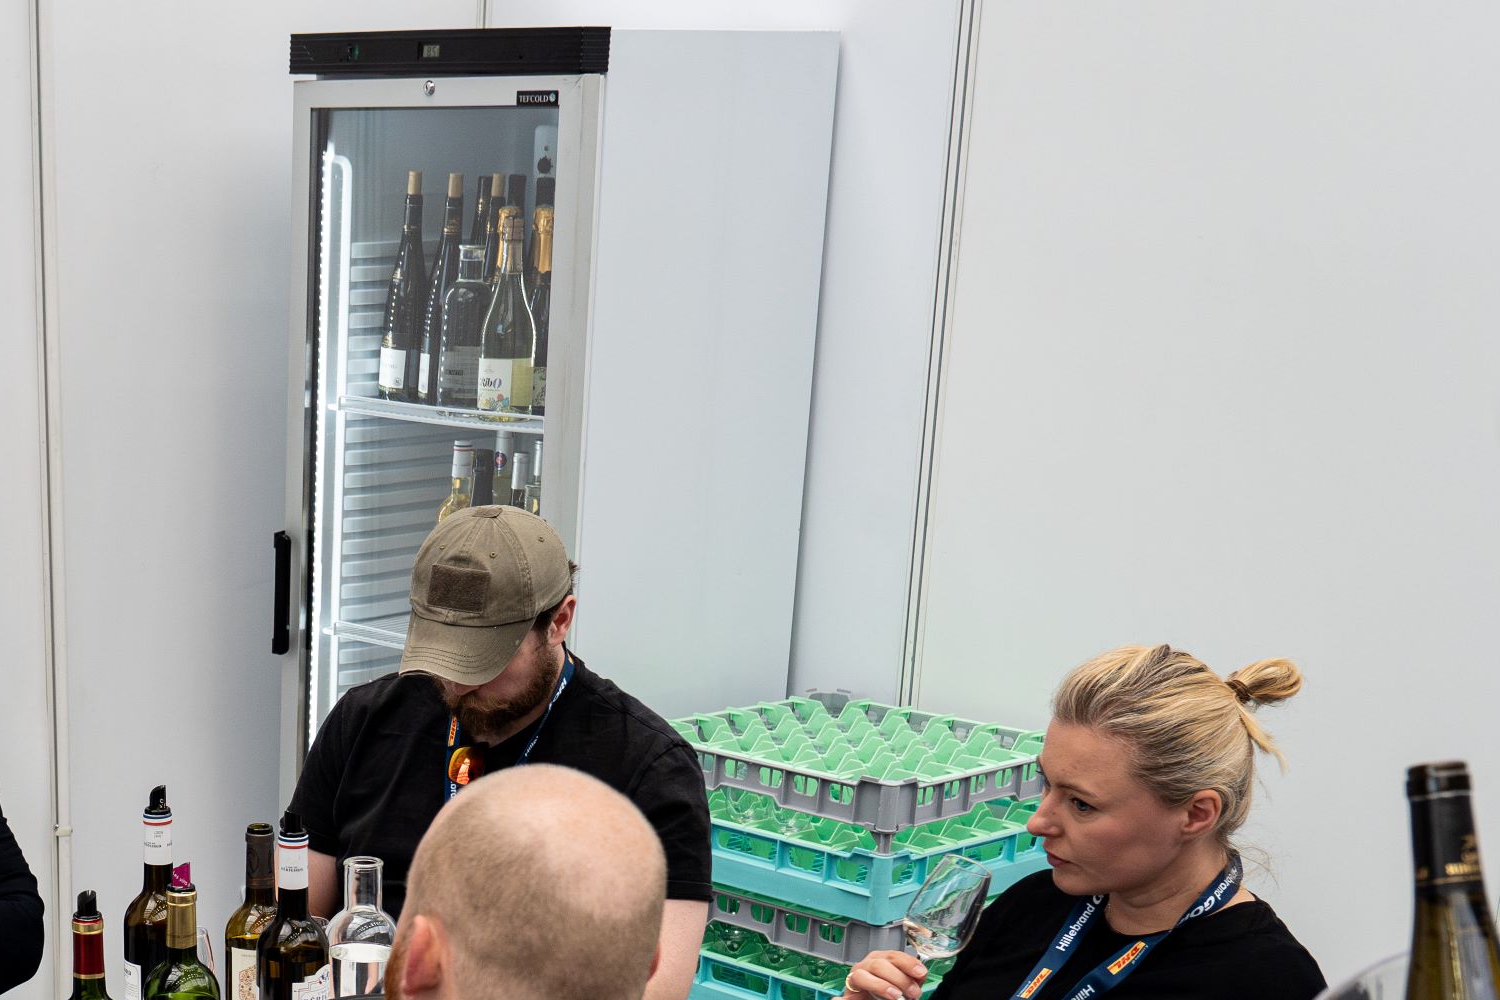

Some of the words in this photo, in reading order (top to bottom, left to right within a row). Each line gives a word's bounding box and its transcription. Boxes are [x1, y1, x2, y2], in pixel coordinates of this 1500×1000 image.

[519, 94, 549, 104] TEFCOLD
[1056, 904, 1096, 952] Hillebrand
[1024, 971, 1049, 997] DHL
